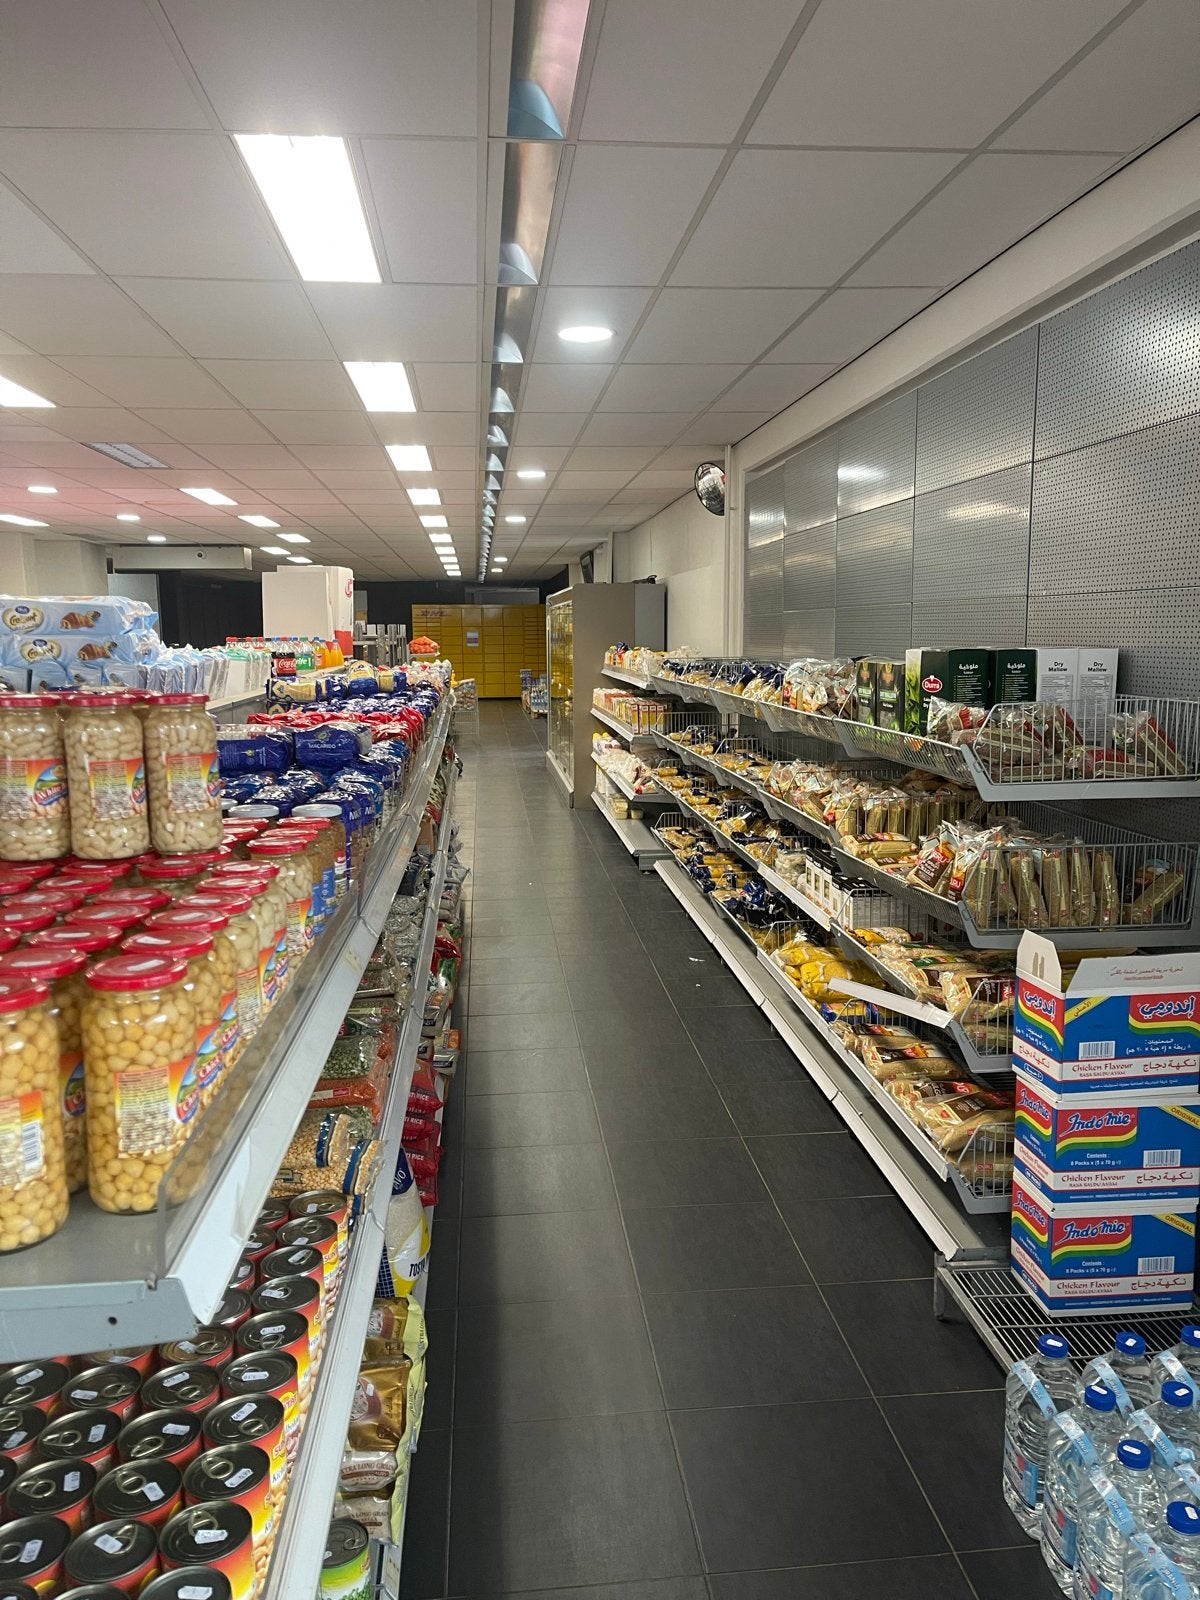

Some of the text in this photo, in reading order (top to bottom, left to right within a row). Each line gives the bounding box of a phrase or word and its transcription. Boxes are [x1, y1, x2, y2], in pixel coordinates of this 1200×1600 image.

[1140, 995, 1196, 1019] إندومي
[1072, 1062, 1134, 1073] Chicken Flavour
[1143, 1059, 1197, 1072] نكهة دجاج
[1171, 1107, 1200, 1126] ORIGINAL
[1060, 1112, 1131, 1137] Indomie
[1061, 1174, 1093, 1182] Chicken
[1136, 1171, 1194, 1184] نكهة دجاج
[1165, 1215, 1193, 1234] ORIGINAL
[1055, 1221, 1125, 1246] Indomie
[1057, 1282, 1088, 1290] Chicken
[1130, 1278, 1187, 1291] نكهة دجاج
